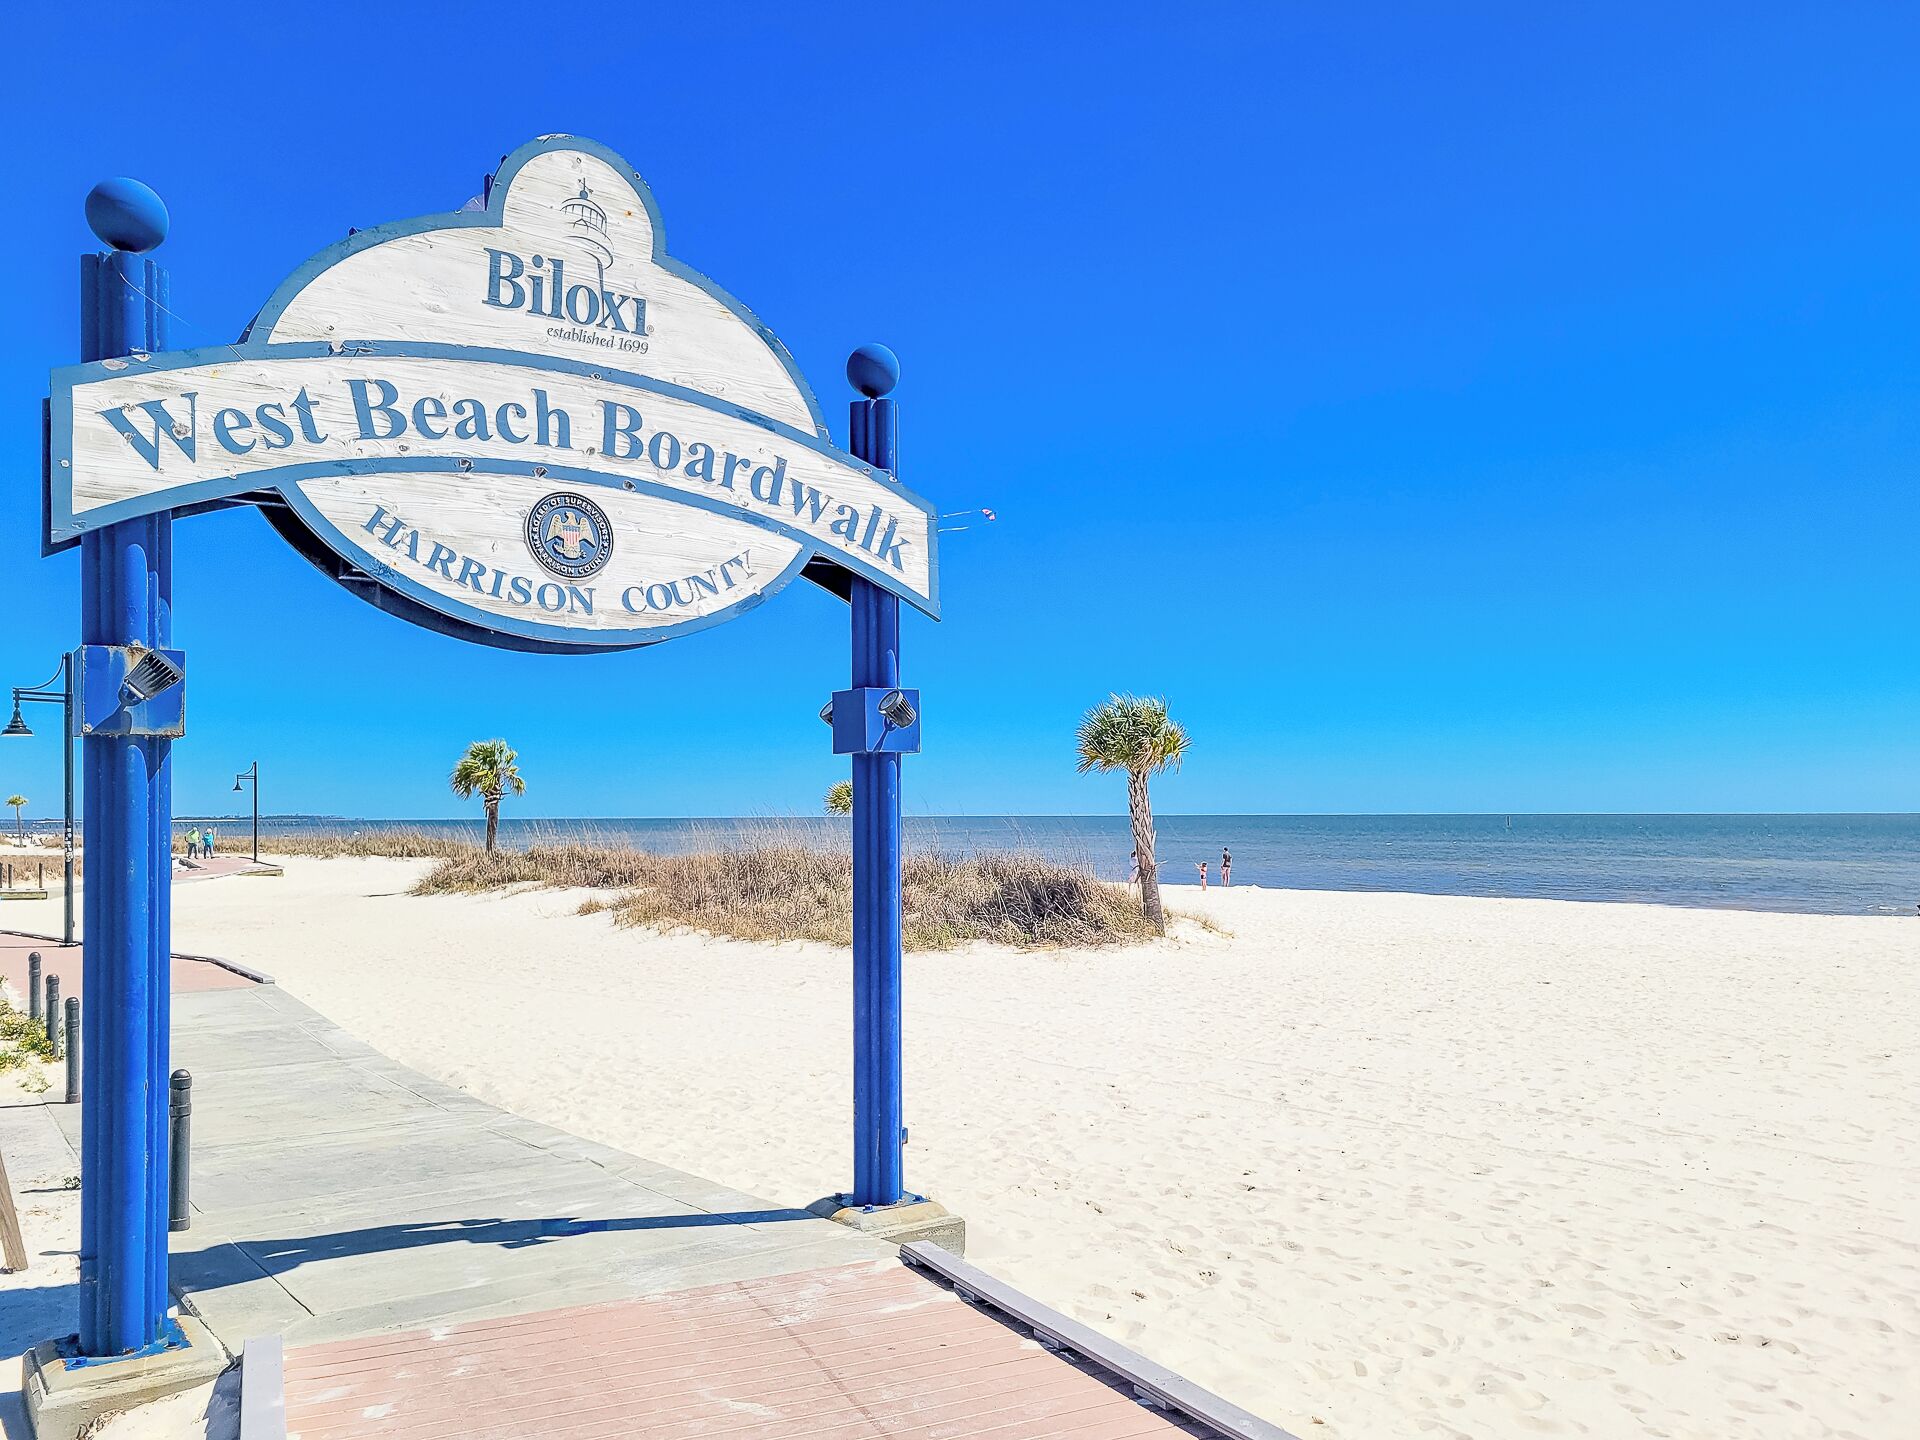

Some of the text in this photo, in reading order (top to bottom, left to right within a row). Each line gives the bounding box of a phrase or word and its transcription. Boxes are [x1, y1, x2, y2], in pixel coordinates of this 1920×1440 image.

[547, 326, 650, 355] established 1699
[94, 378, 911, 573] West Beach Boardwalk
[532, 496, 610, 540] BOARD OF SUPERVISORS
[360, 504, 758, 617] HARRISON COUNTY
[534, 541, 608, 574] HARRISON COUNTY
